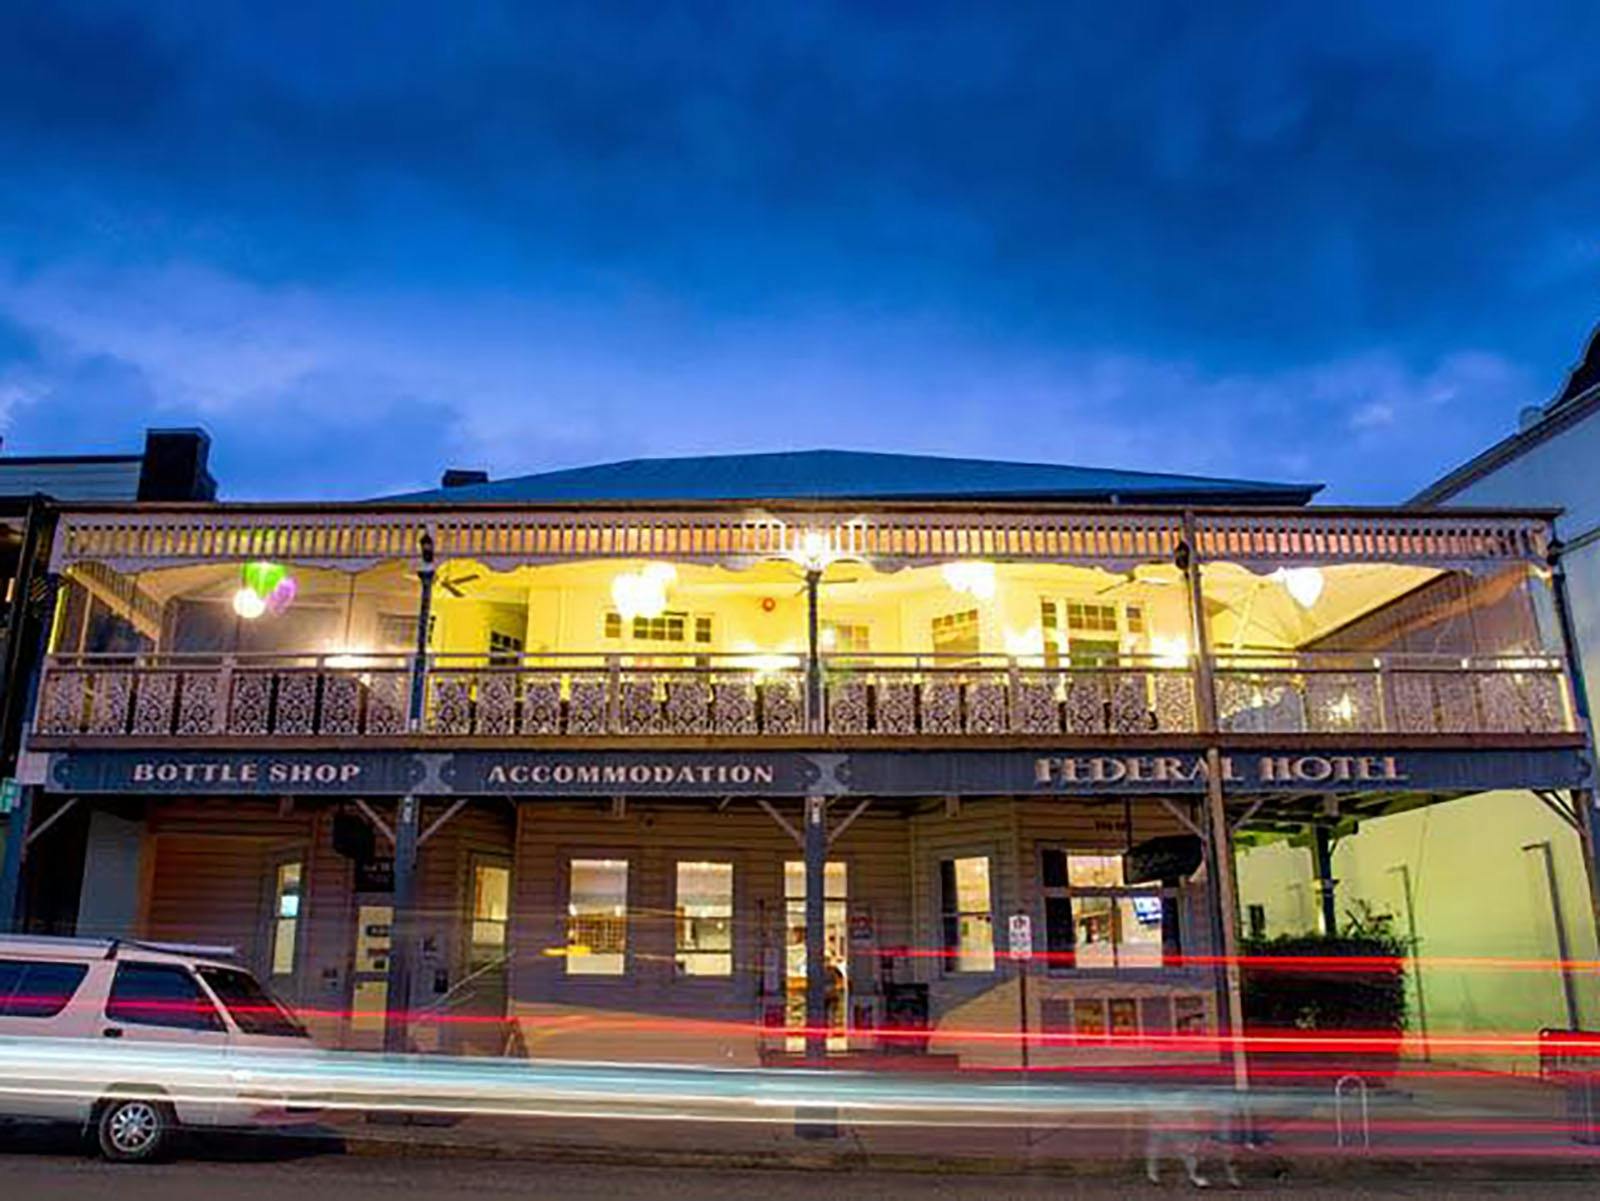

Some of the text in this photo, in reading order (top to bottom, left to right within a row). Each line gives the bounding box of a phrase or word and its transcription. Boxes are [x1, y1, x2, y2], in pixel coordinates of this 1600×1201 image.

[133, 763, 361, 783] BOTTLE SHOP
[487, 765, 774, 784] ACCOMMODATION
[1034, 756, 1409, 783] FEDERAL HOTEL
